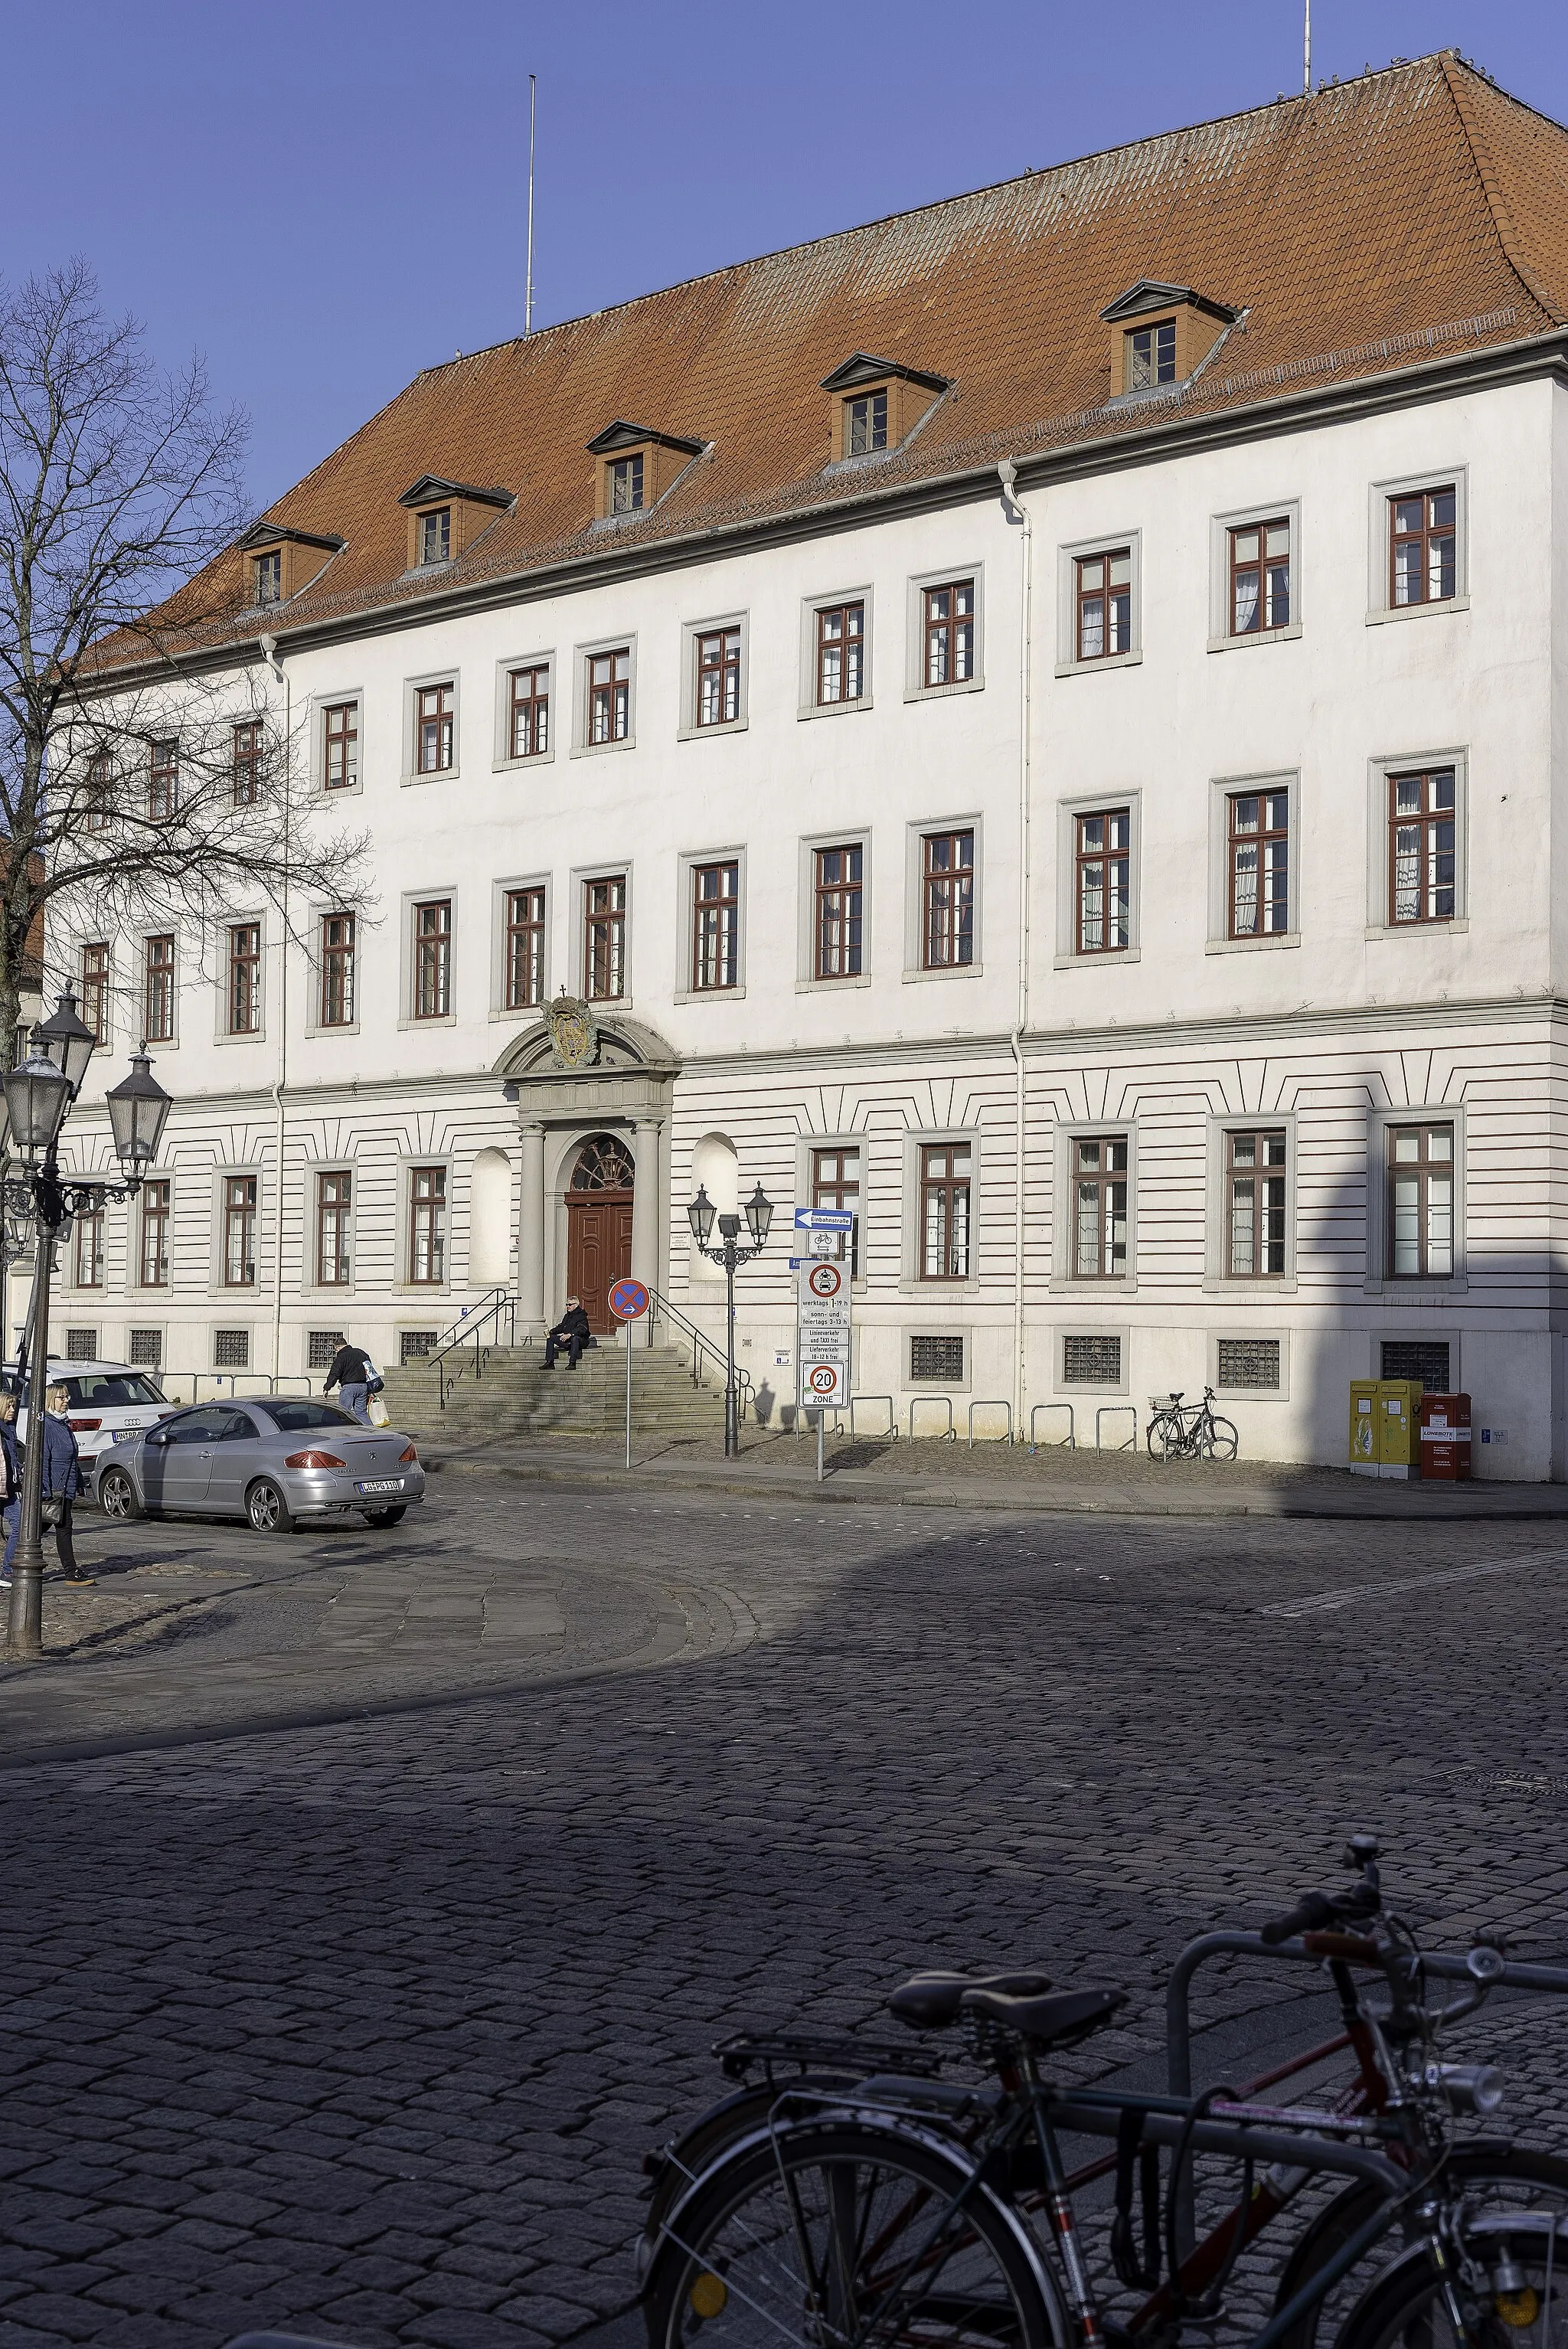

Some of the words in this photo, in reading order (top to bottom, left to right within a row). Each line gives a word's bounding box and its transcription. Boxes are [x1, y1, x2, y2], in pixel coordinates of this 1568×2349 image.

[811, 1216, 849, 1224] Einbahnstraße
[816, 1374, 831, 1387] 20
[813, 1395, 834, 1403] ZONE
[363, 1482, 373, 1491] LG
[377, 1482, 386, 1491] PG
[386, 1481, 398, 1490] 110
